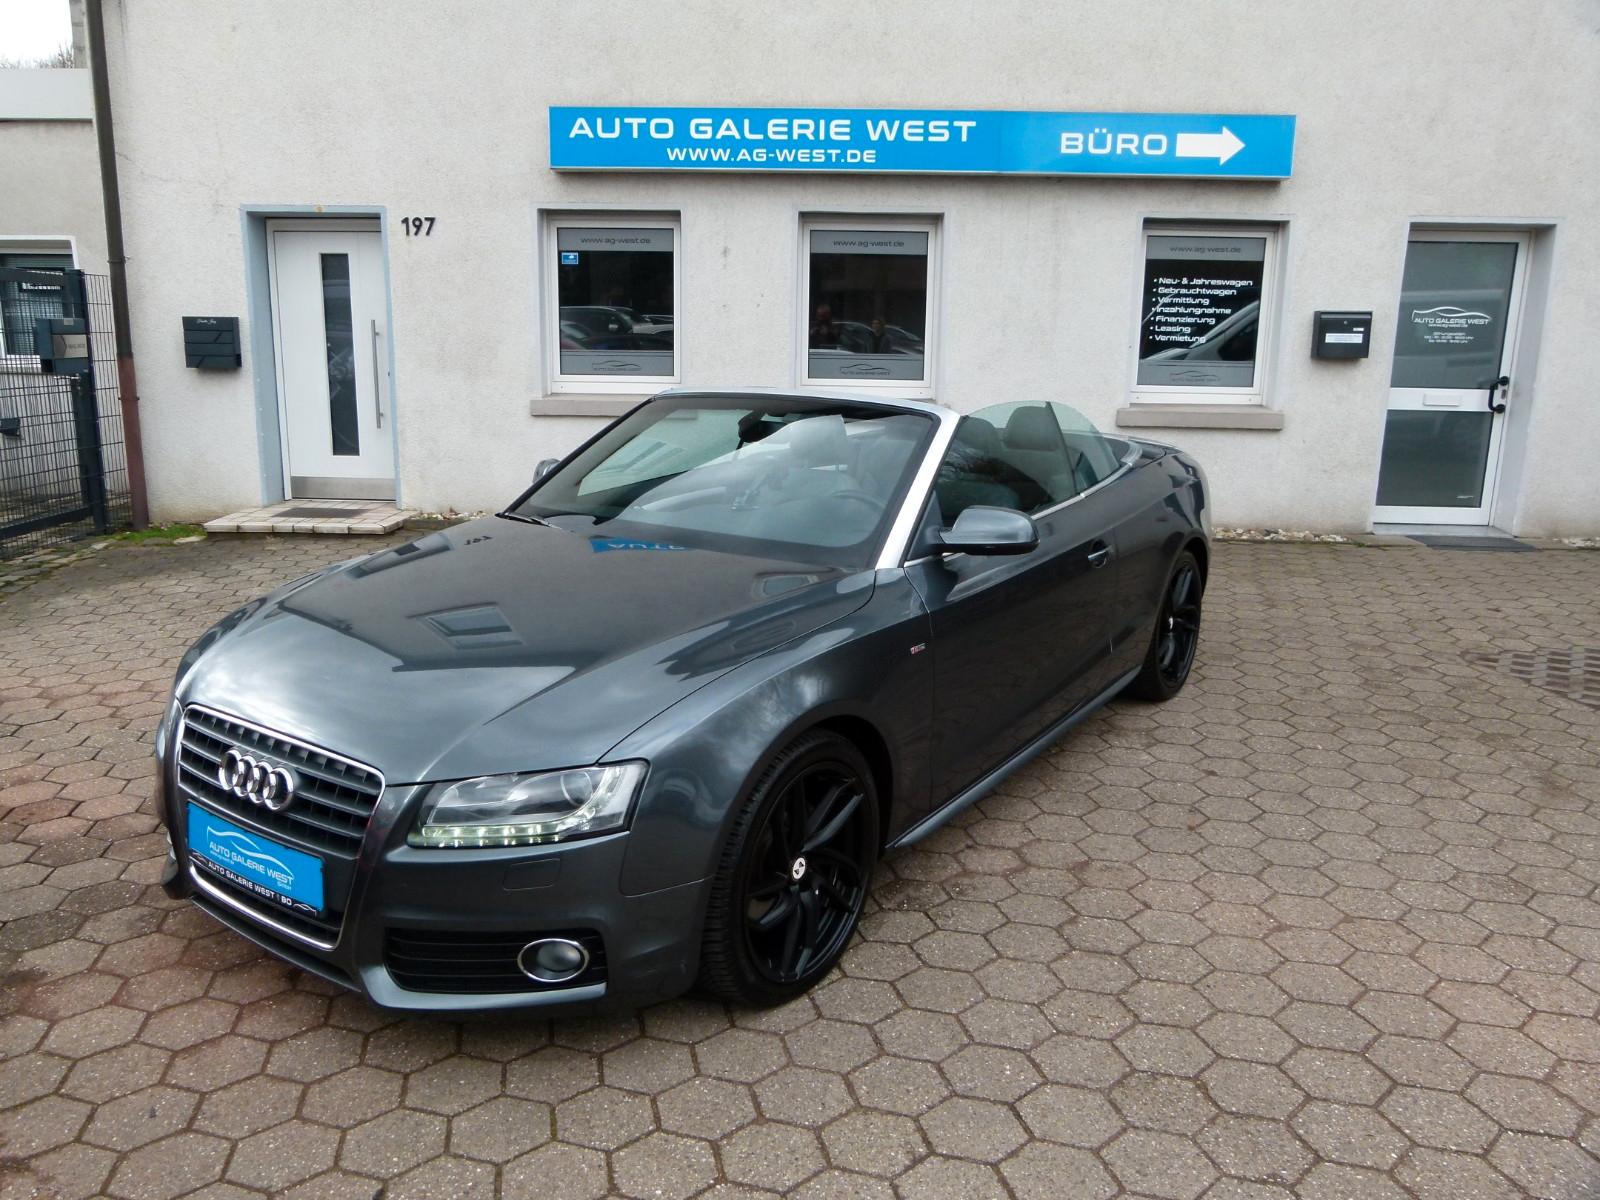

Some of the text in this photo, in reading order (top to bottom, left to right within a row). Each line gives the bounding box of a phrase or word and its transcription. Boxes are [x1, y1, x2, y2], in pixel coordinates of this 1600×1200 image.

[568, 117, 977, 143] AUTO GALERIE WEST
[1060, 127, 1168, 155] BÜRO
[666, 147, 877, 164] WWW.AG-WEST.DE
[400, 216, 436, 237] 197
[580, 236, 652, 245] www.ag-west.de
[832, 239, 905, 248] www.ag-west.de
[1158, 277, 1181, 285] Neu-
[1190, 278, 1253, 286] Jahreswagen
[1158, 287, 1237, 296] Gebrauchtwagen
[1158, 297, 1210, 305] Vermittlung
[1156, 306, 1232, 315] Inzahlungnahme
[1155, 316, 1216, 324] Finanzierung
[1155, 325, 1191, 333] Leasing
[1154, 334, 1206, 343] Vermietung
[209, 841, 293, 885] AUTO GALERIE WEST
[208, 862, 225, 875] AUTO
[226, 869, 254, 889] GALERIE
[254, 882, 276, 900] WEST
